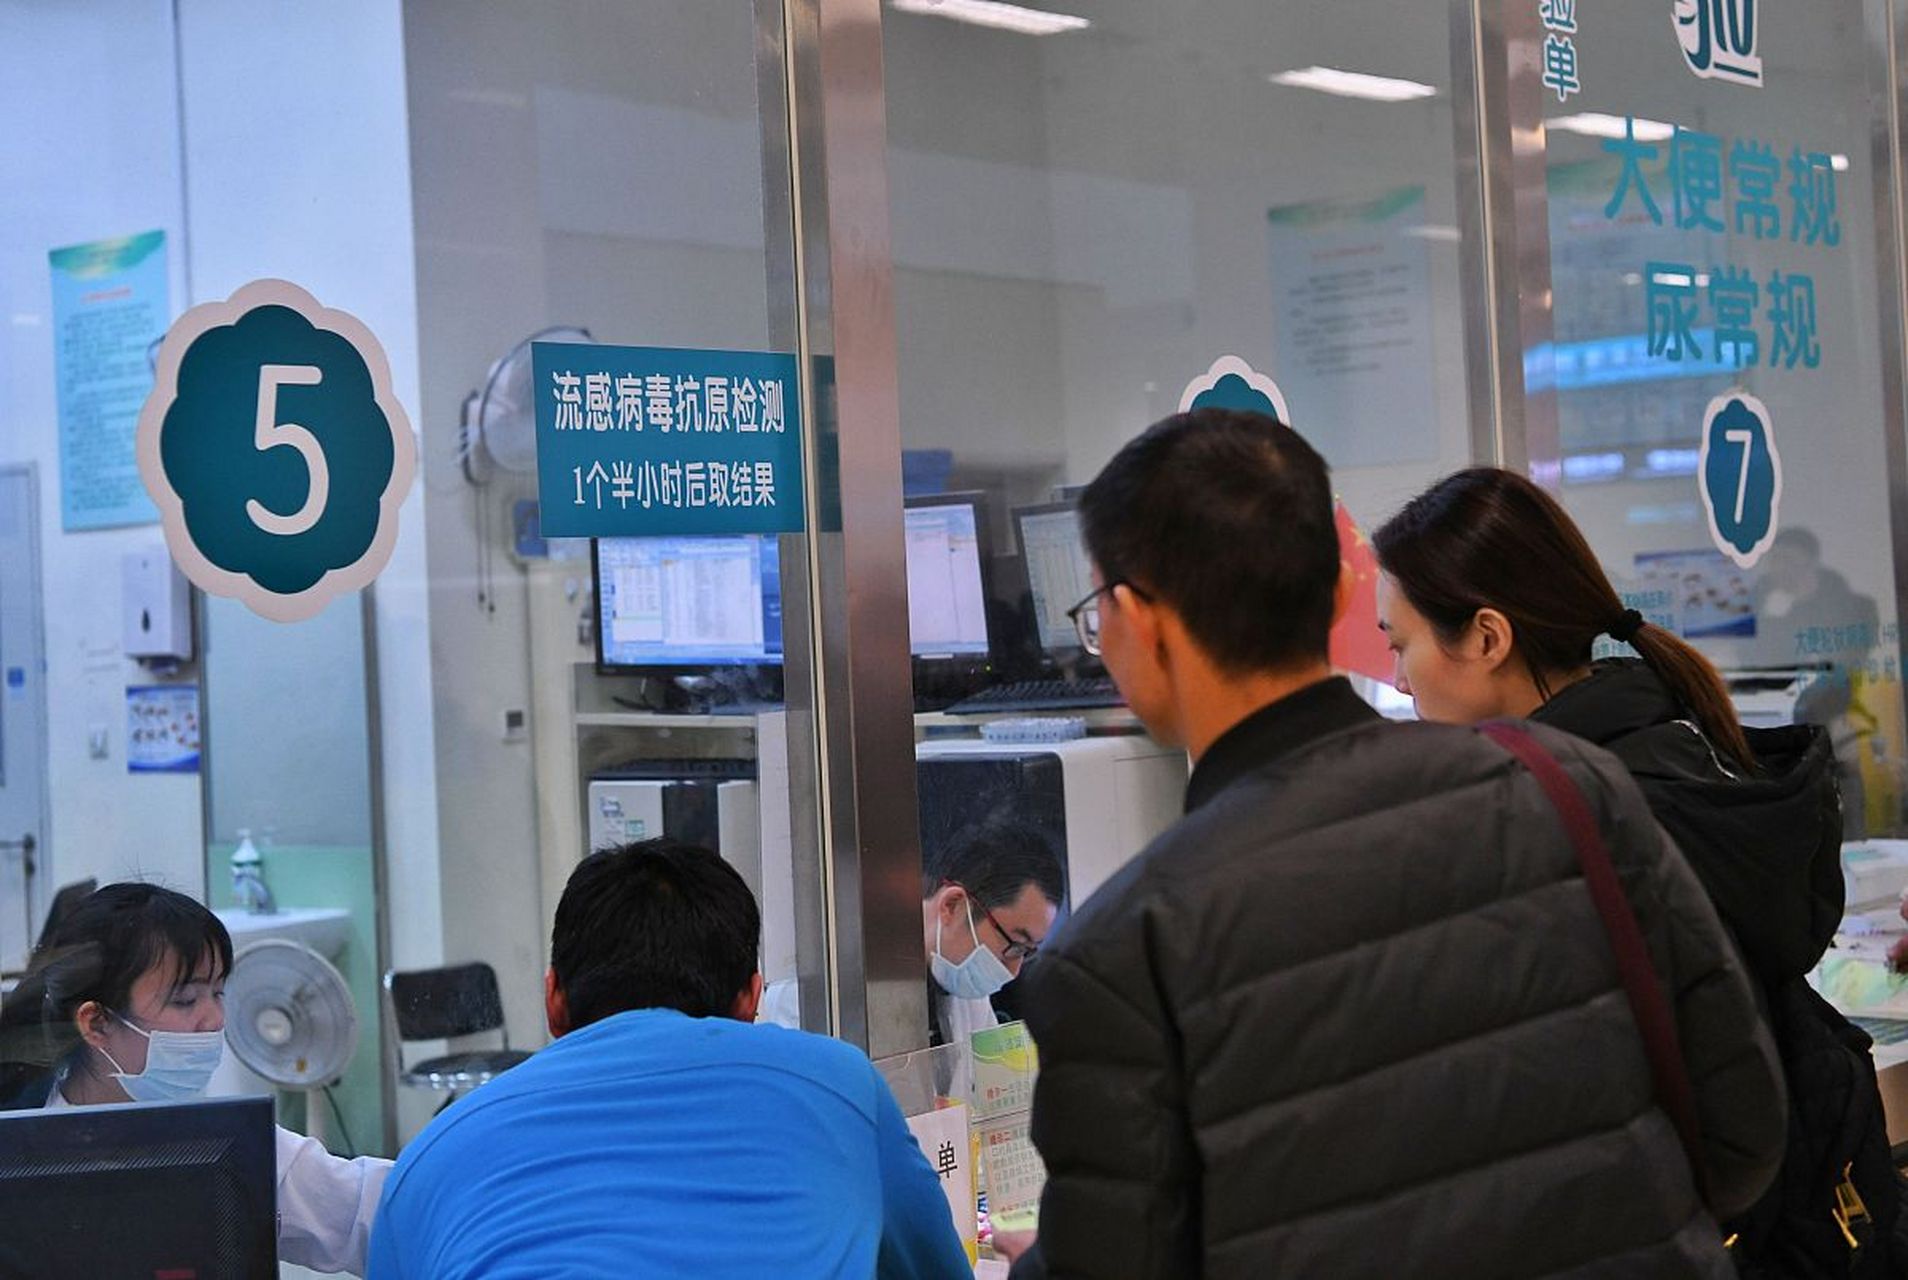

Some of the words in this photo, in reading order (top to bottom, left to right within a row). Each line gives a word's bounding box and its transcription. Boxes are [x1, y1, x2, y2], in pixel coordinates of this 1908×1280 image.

[1601, 116, 1841, 247] 大便常规
[1645, 261, 1820, 370] 尿常规
[552, 370, 786, 433] 流感病毒抗原检测
[246, 364, 329, 536] 5
[572, 460, 775, 509] 1个半小时后取结果
[1725, 429, 1752, 524] 7
[938, 1140, 958, 1179] 单
